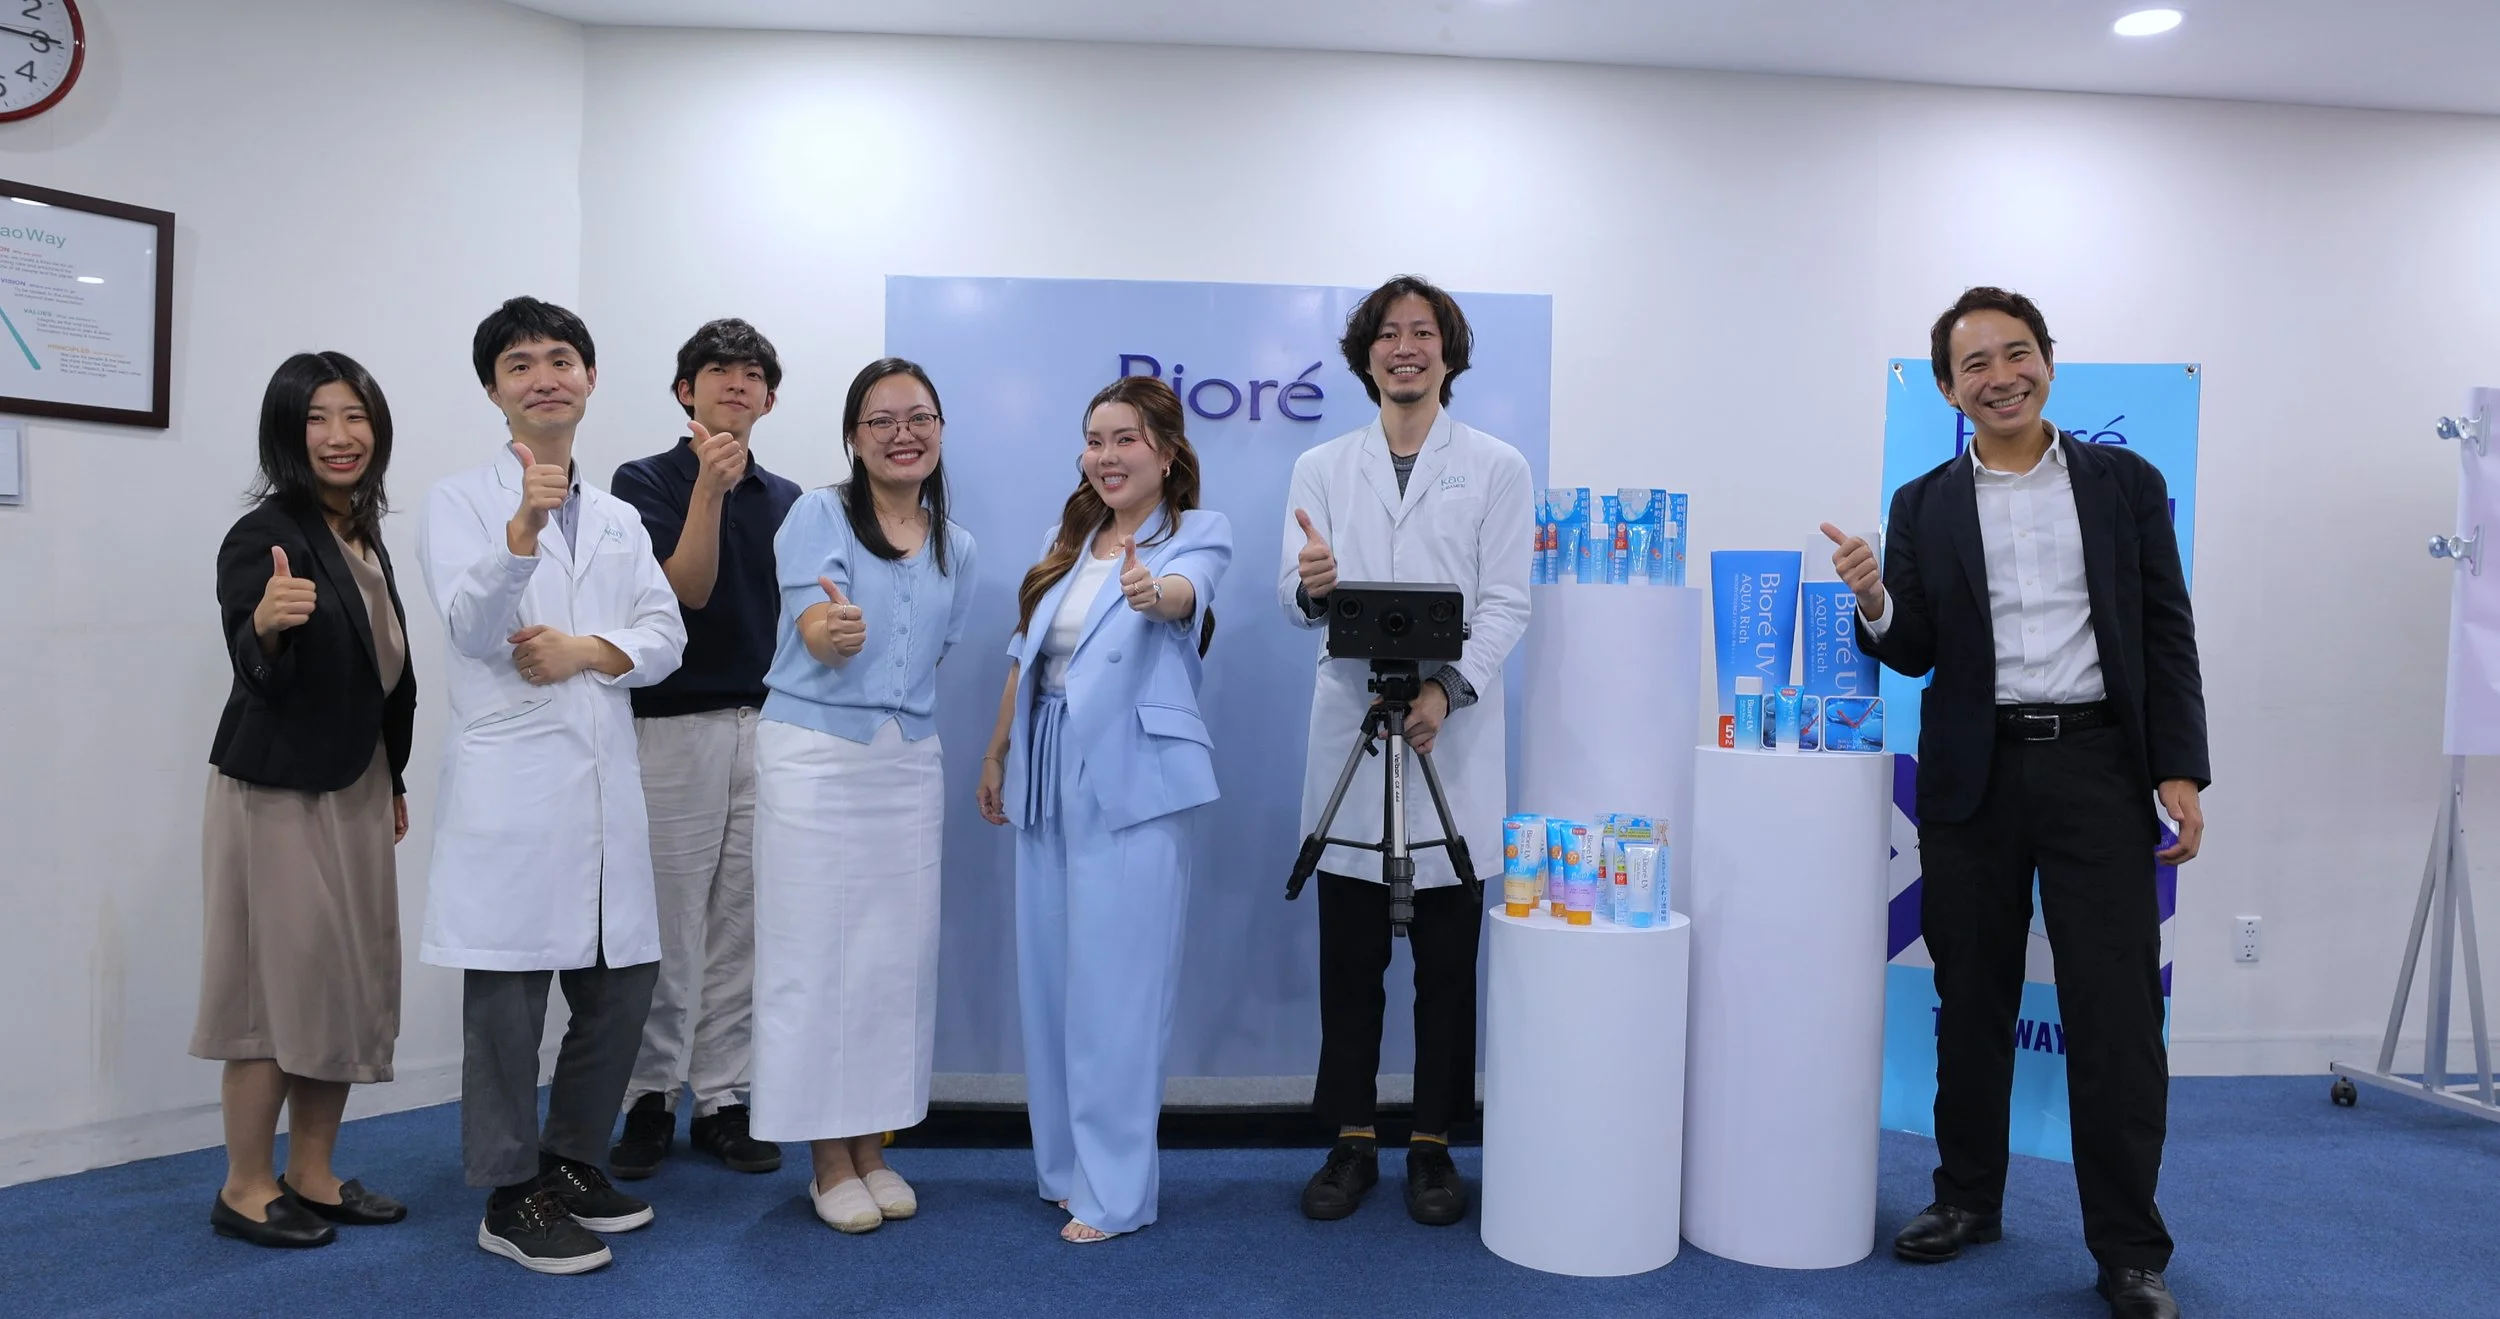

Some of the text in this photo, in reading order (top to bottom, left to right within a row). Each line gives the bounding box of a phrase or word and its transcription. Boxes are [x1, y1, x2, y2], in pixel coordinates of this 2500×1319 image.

[21, 0, 42, 20] 2
[30, 29, 50, 53] 3
[15, 60, 37, 82] 4
[0, 226, 66, 249] ao Way
[1738, 573, 1752, 644] AQUA Rich
[1755, 573, 1780, 677] Bioré UV
[1816, 594, 1828, 673] AQUA Rich
[1834, 592, 1859, 664] Bioré
[1725, 724, 1734, 739] 5
